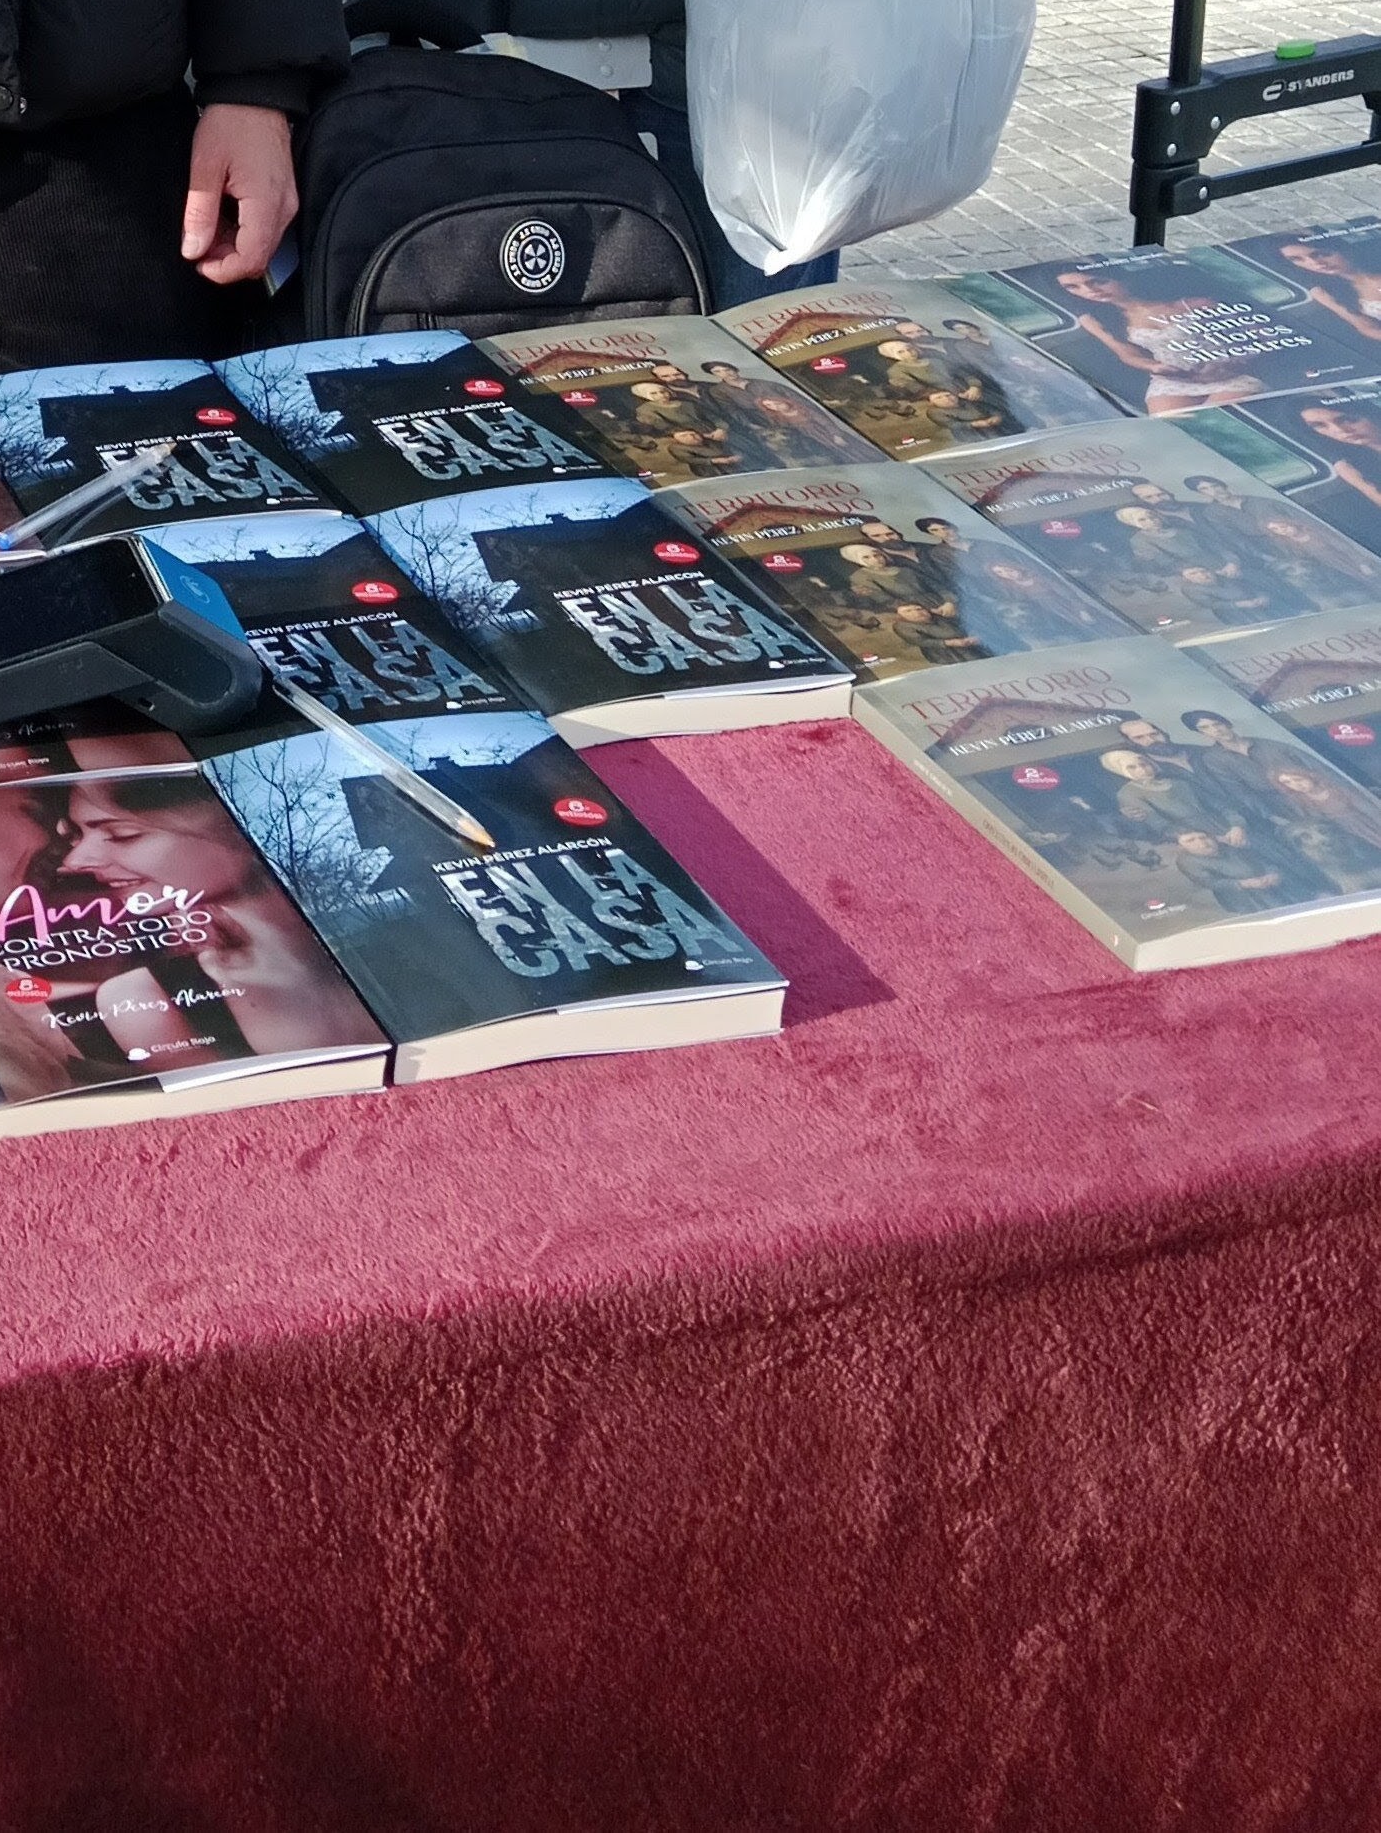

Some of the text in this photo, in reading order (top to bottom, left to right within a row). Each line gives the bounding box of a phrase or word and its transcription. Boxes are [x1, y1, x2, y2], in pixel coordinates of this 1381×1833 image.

[1148, 302, 1252, 325] Vestido
[1176, 313, 1271, 336] blanco
[1166, 324, 1294, 354] de flores
[1183, 335, 1313, 364] silvestres
[402, 424, 602, 481] CASA
[121, 458, 315, 511] CASA
[553, 570, 705, 601] KEVIN PÉREZ ALARCÓN
[559, 579, 745, 632] EN LA
[350, 619, 430, 659] LA
[592, 611, 824, 675] CASA
[901, 665, 1113, 720] TERRITORIO
[949, 735, 1000, 758] KEVIN
[998, 725, 1050, 746] PÉREZ
[1051, 712, 1124, 737] ALARCÓN
[432, 835, 612, 875] KEVIN PÉREZ ALARCÓN
[440, 848, 660, 923] EN LA
[119, 909, 213, 939] TODO
[475, 893, 746, 979] CASA
[3, 926, 208, 973] PRONÓSTICO
[40, 1007, 107, 1030] Kevin
